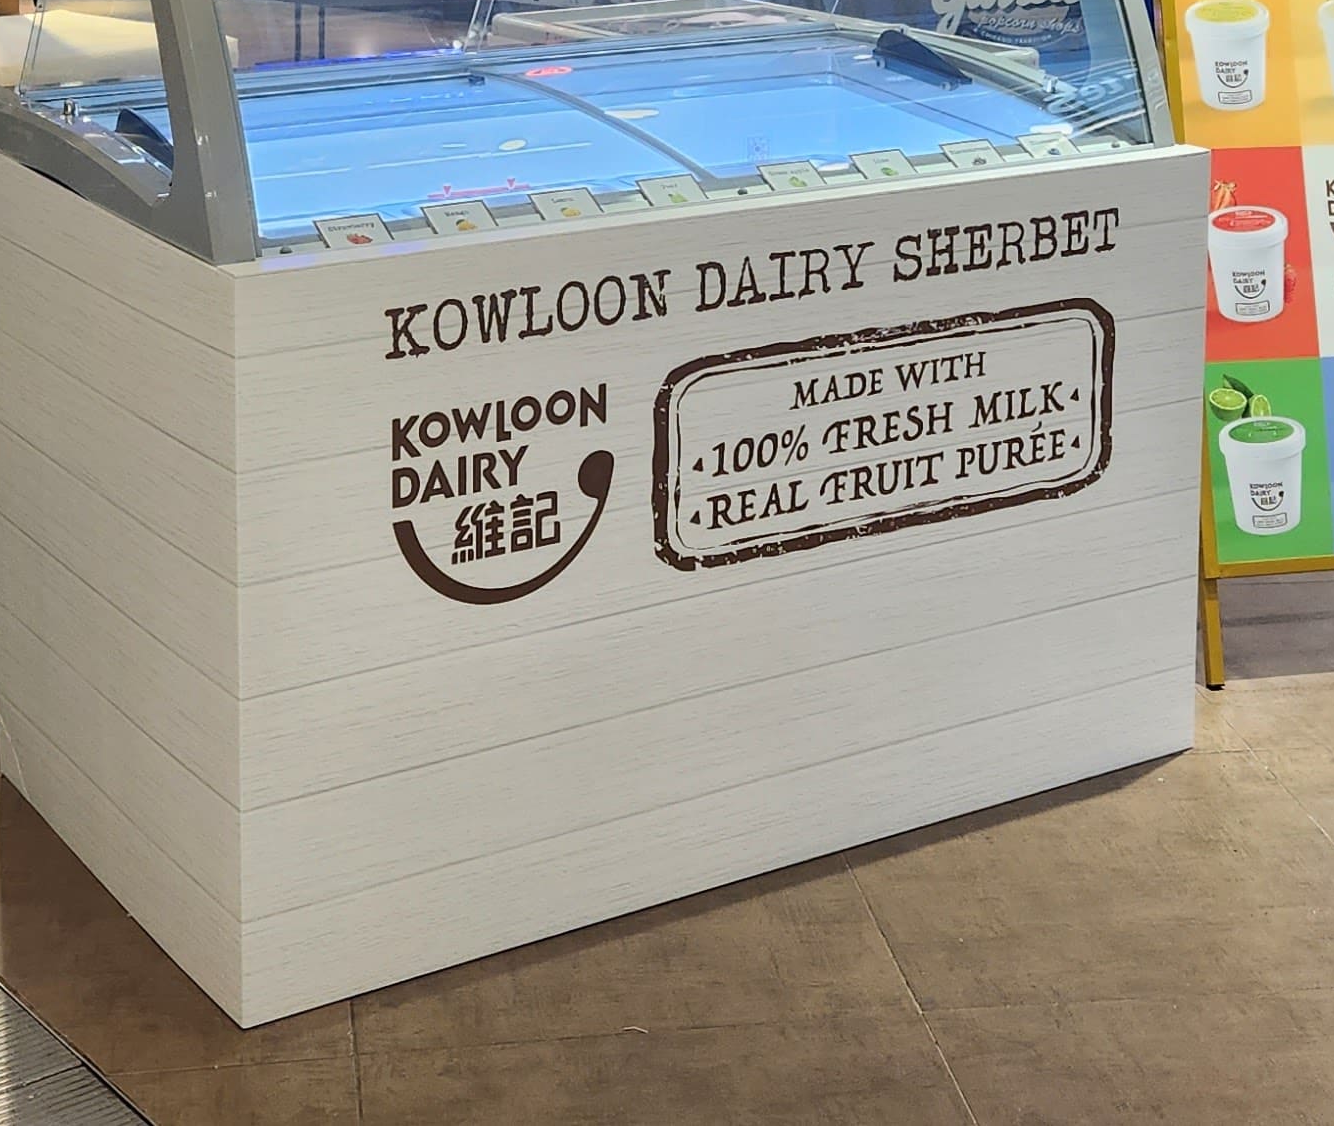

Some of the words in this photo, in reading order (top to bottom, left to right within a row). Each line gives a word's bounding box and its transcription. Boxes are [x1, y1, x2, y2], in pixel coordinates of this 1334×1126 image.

[977, 16, 1037, 29] popcorn
[385, 269, 671, 359] KOWLOON
[696, 241, 875, 314] DAIRY
[893, 207, 1121, 284] SHERBET
[790, 367, 885, 410] MADE
[893, 351, 987, 392] WITH
[391, 382, 608, 461] KOWLOON
[710, 424, 810, 478] 100%
[821, 406, 953, 458] FRESH
[971, 379, 1065, 432] MILK
[391, 445, 530, 509] DAIRY
[707, 480, 809, 531] REAL
[820, 457, 945, 506] FRUIT
[955, 420, 1068, 481] PURÉE
[450, 491, 561, 565] 維記
